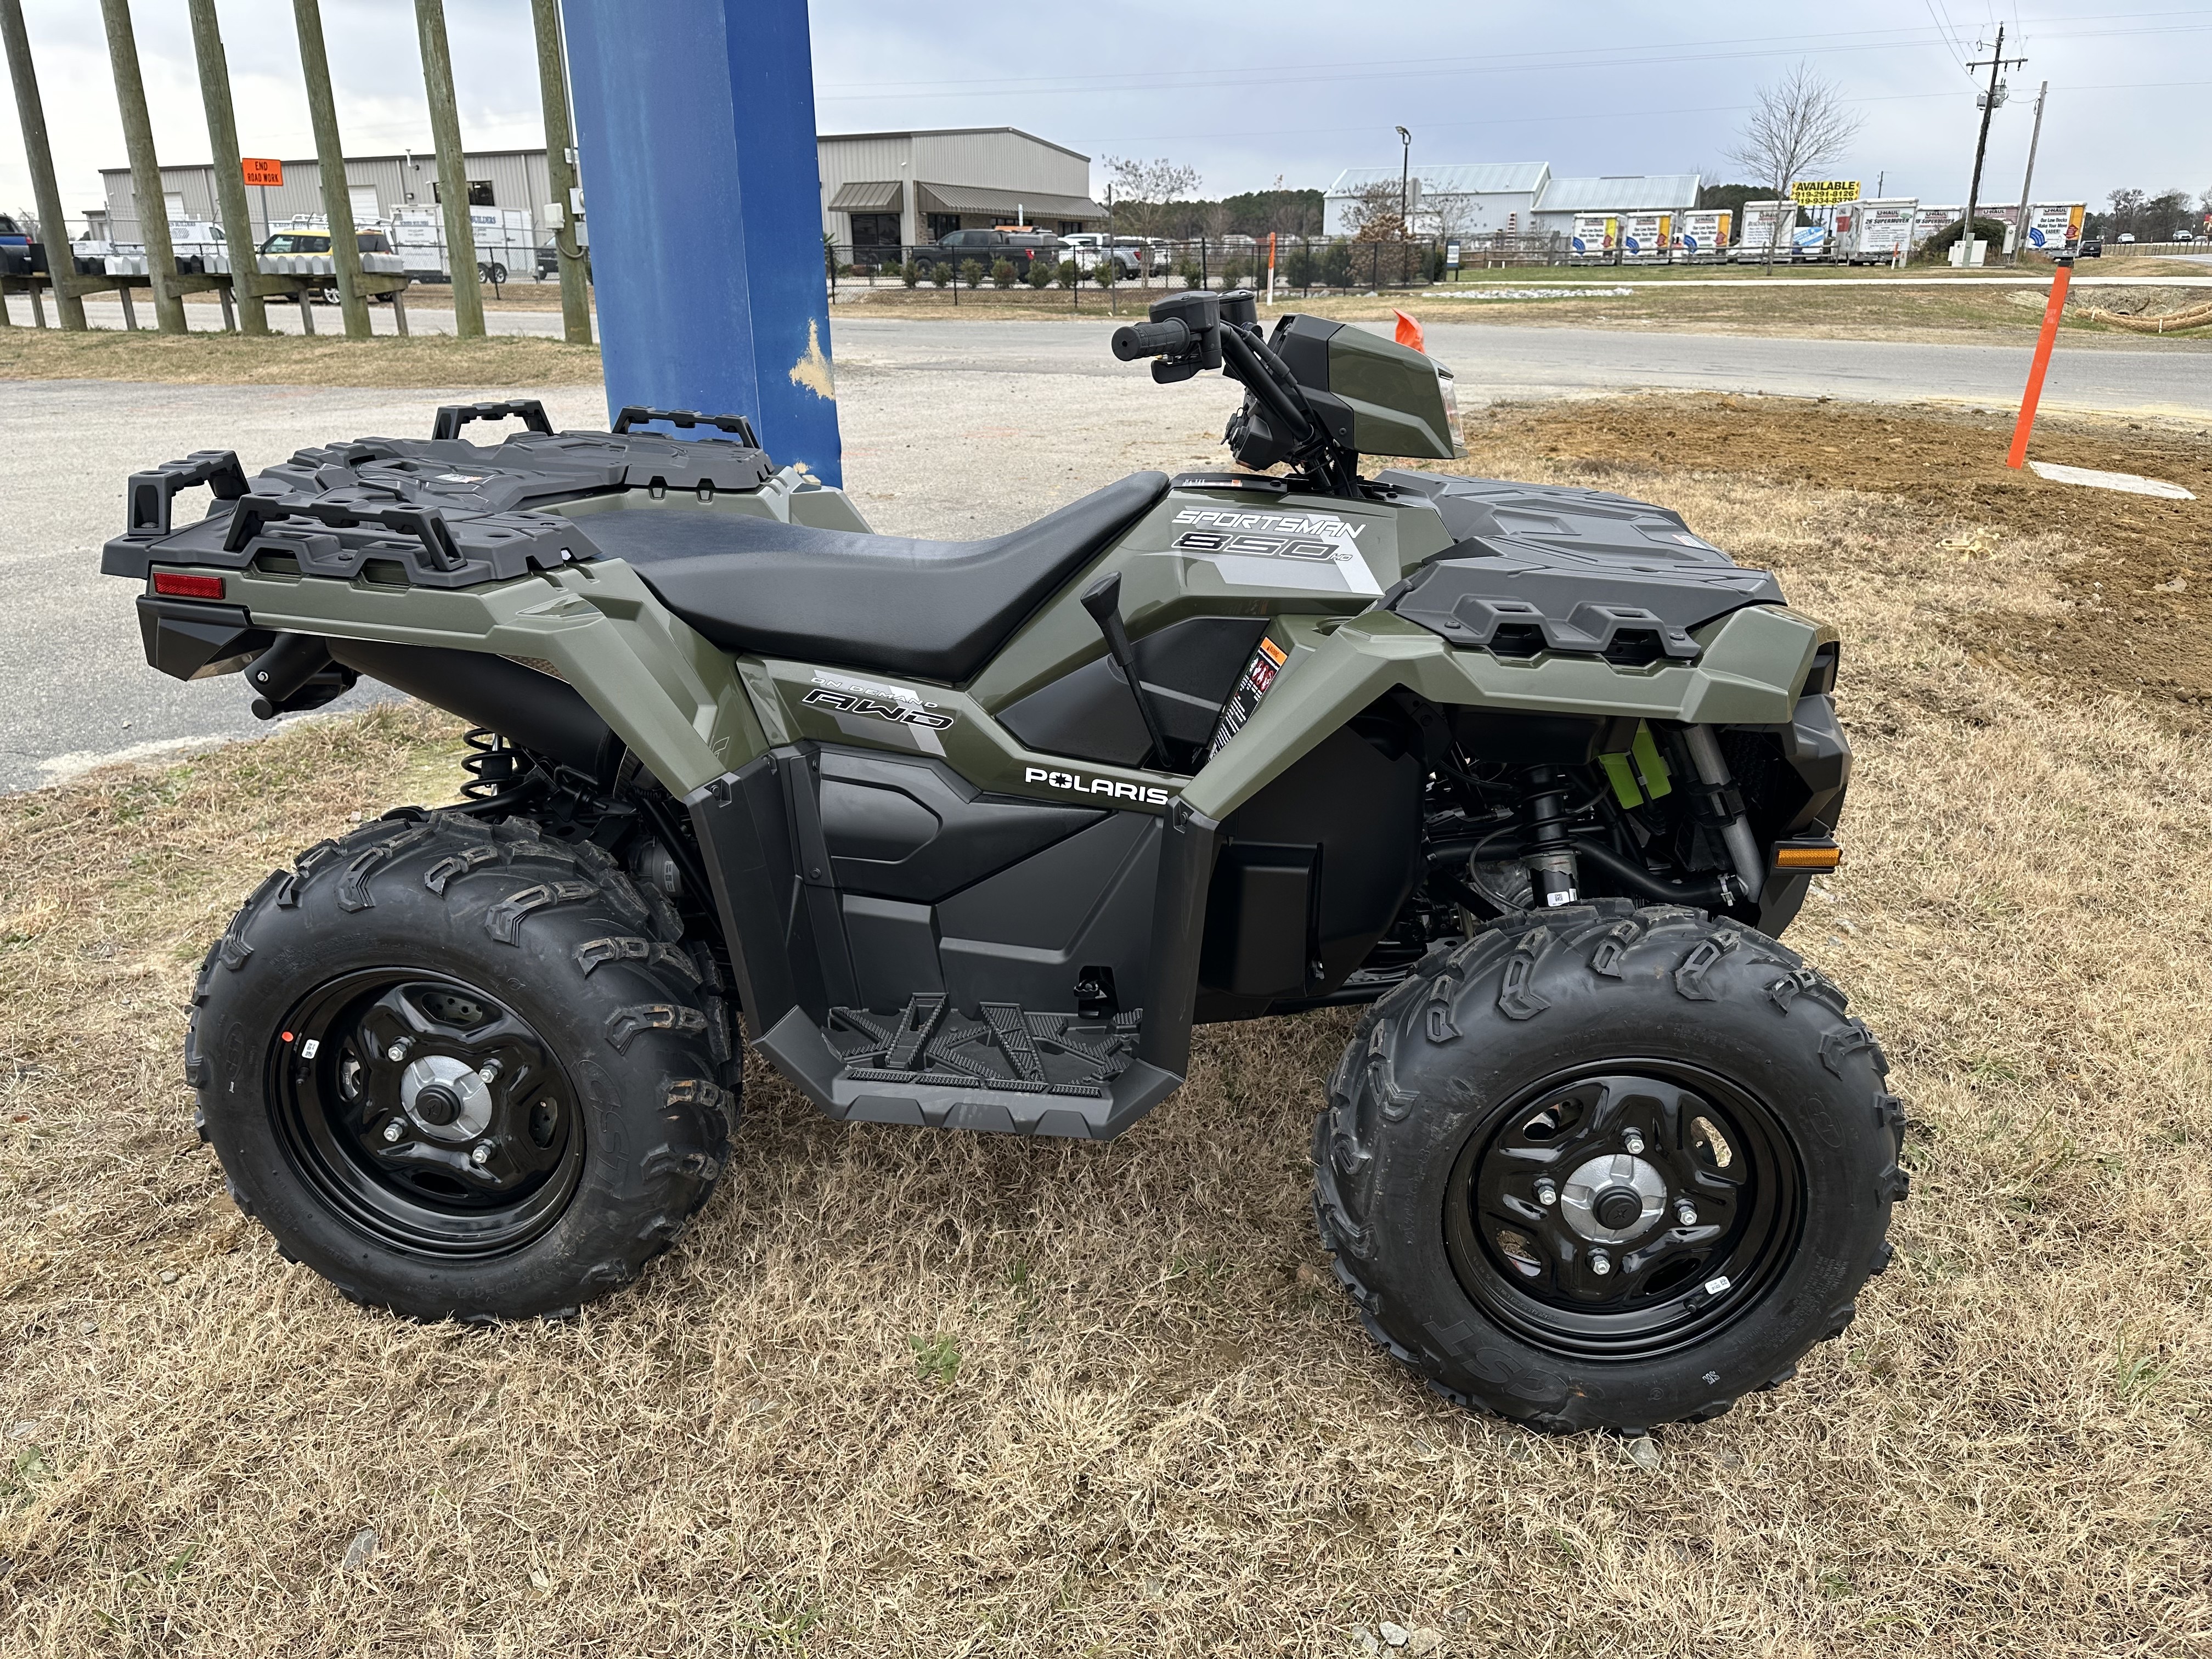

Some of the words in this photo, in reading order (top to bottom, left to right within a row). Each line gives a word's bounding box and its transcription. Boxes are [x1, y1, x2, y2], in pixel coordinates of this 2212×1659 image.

[247, 173, 262, 182] ROAD
[263, 173, 279, 182] WORK
[255, 161, 268, 171] END
[1796, 182, 1855, 190] AVAILABLE
[1171, 510, 1367, 539] SPORTSMAN
[1171, 532, 1341, 561] 850
[1330, 552, 1353, 561] HD
[810, 676, 842, 688] ON
[850, 685, 939, 709] DEMAND
[802, 689, 954, 730] AWD
[1025, 767, 1169, 805] POLARIS
[578, 1059, 630, 1200] CST
[1422, 1319, 1569, 1402] CST
